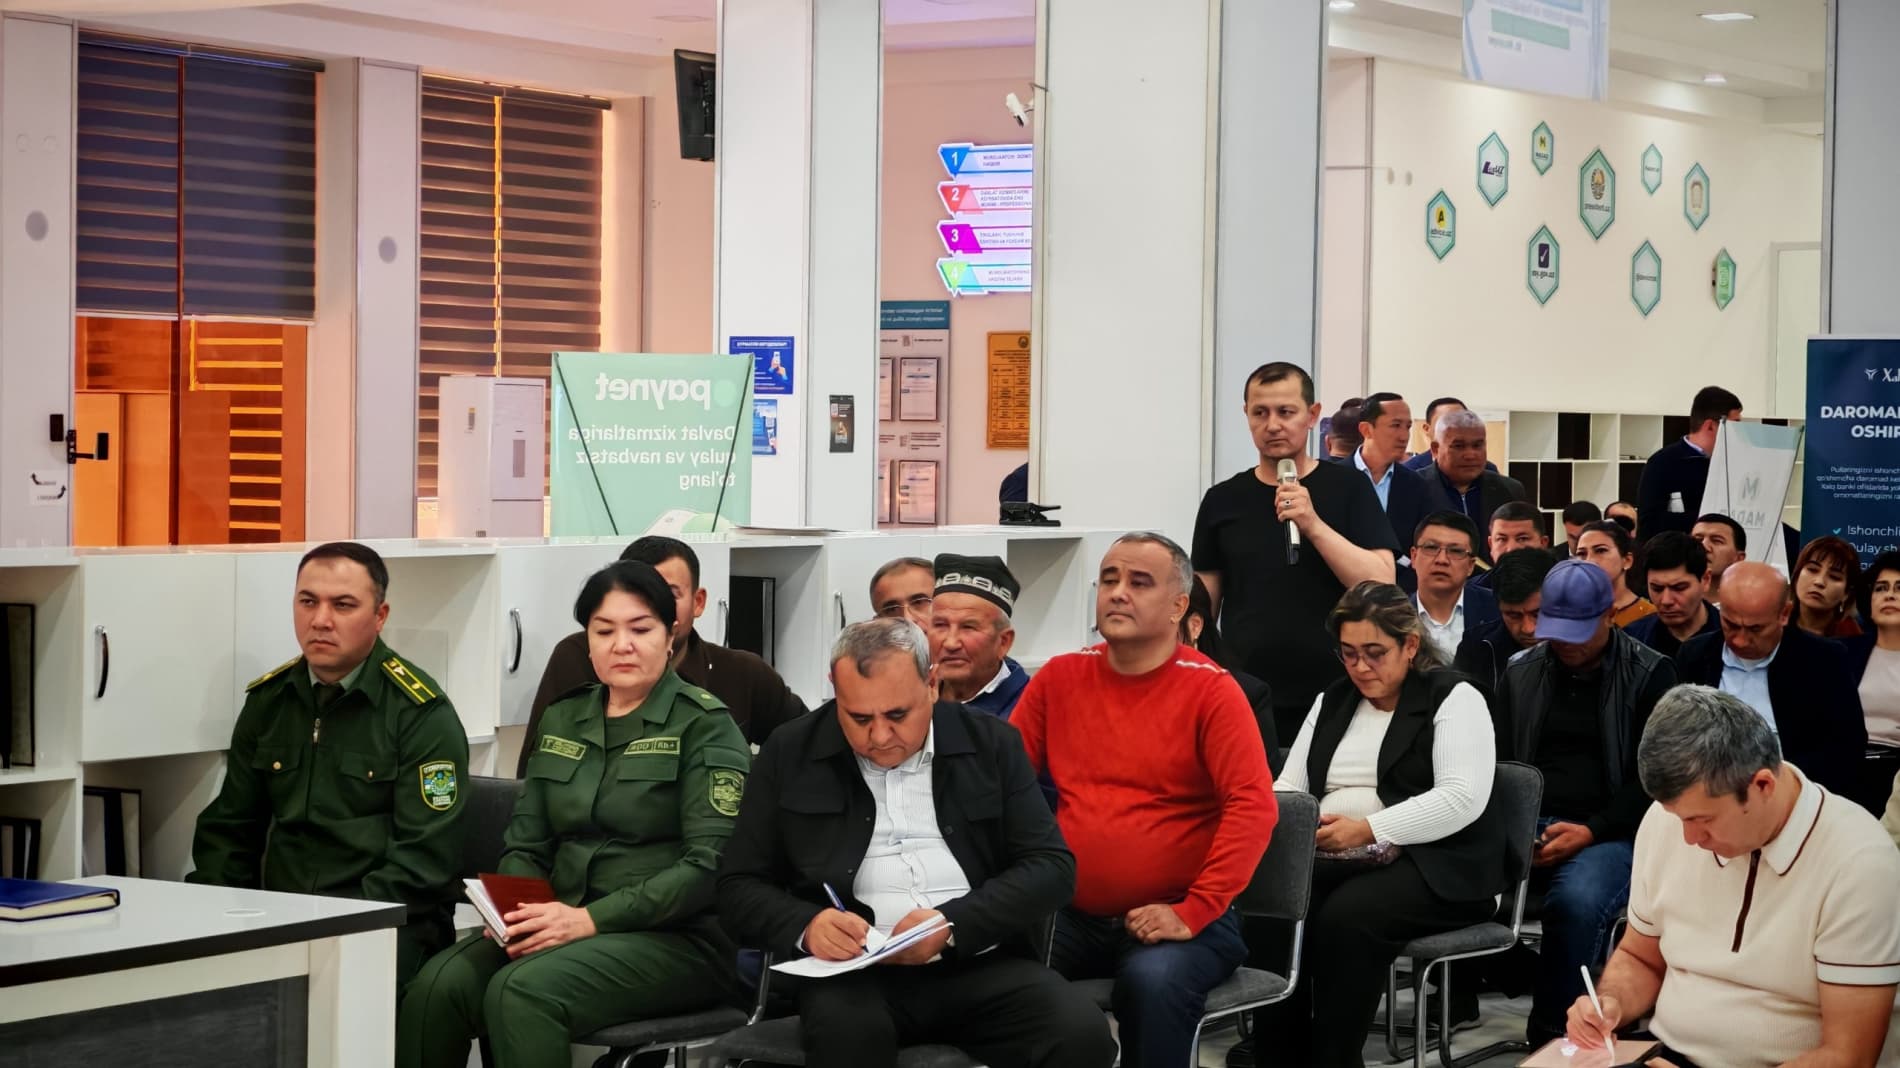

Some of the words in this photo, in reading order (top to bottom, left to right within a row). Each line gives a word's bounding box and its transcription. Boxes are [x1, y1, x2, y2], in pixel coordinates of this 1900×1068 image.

[951, 151, 958, 167] 1
[951, 187, 960, 201] 2
[1437, 209, 1445, 223] A
[951, 228, 959, 243] 3
[950, 266, 958, 280] 4
[1820, 405, 1900, 419] DAROMA
